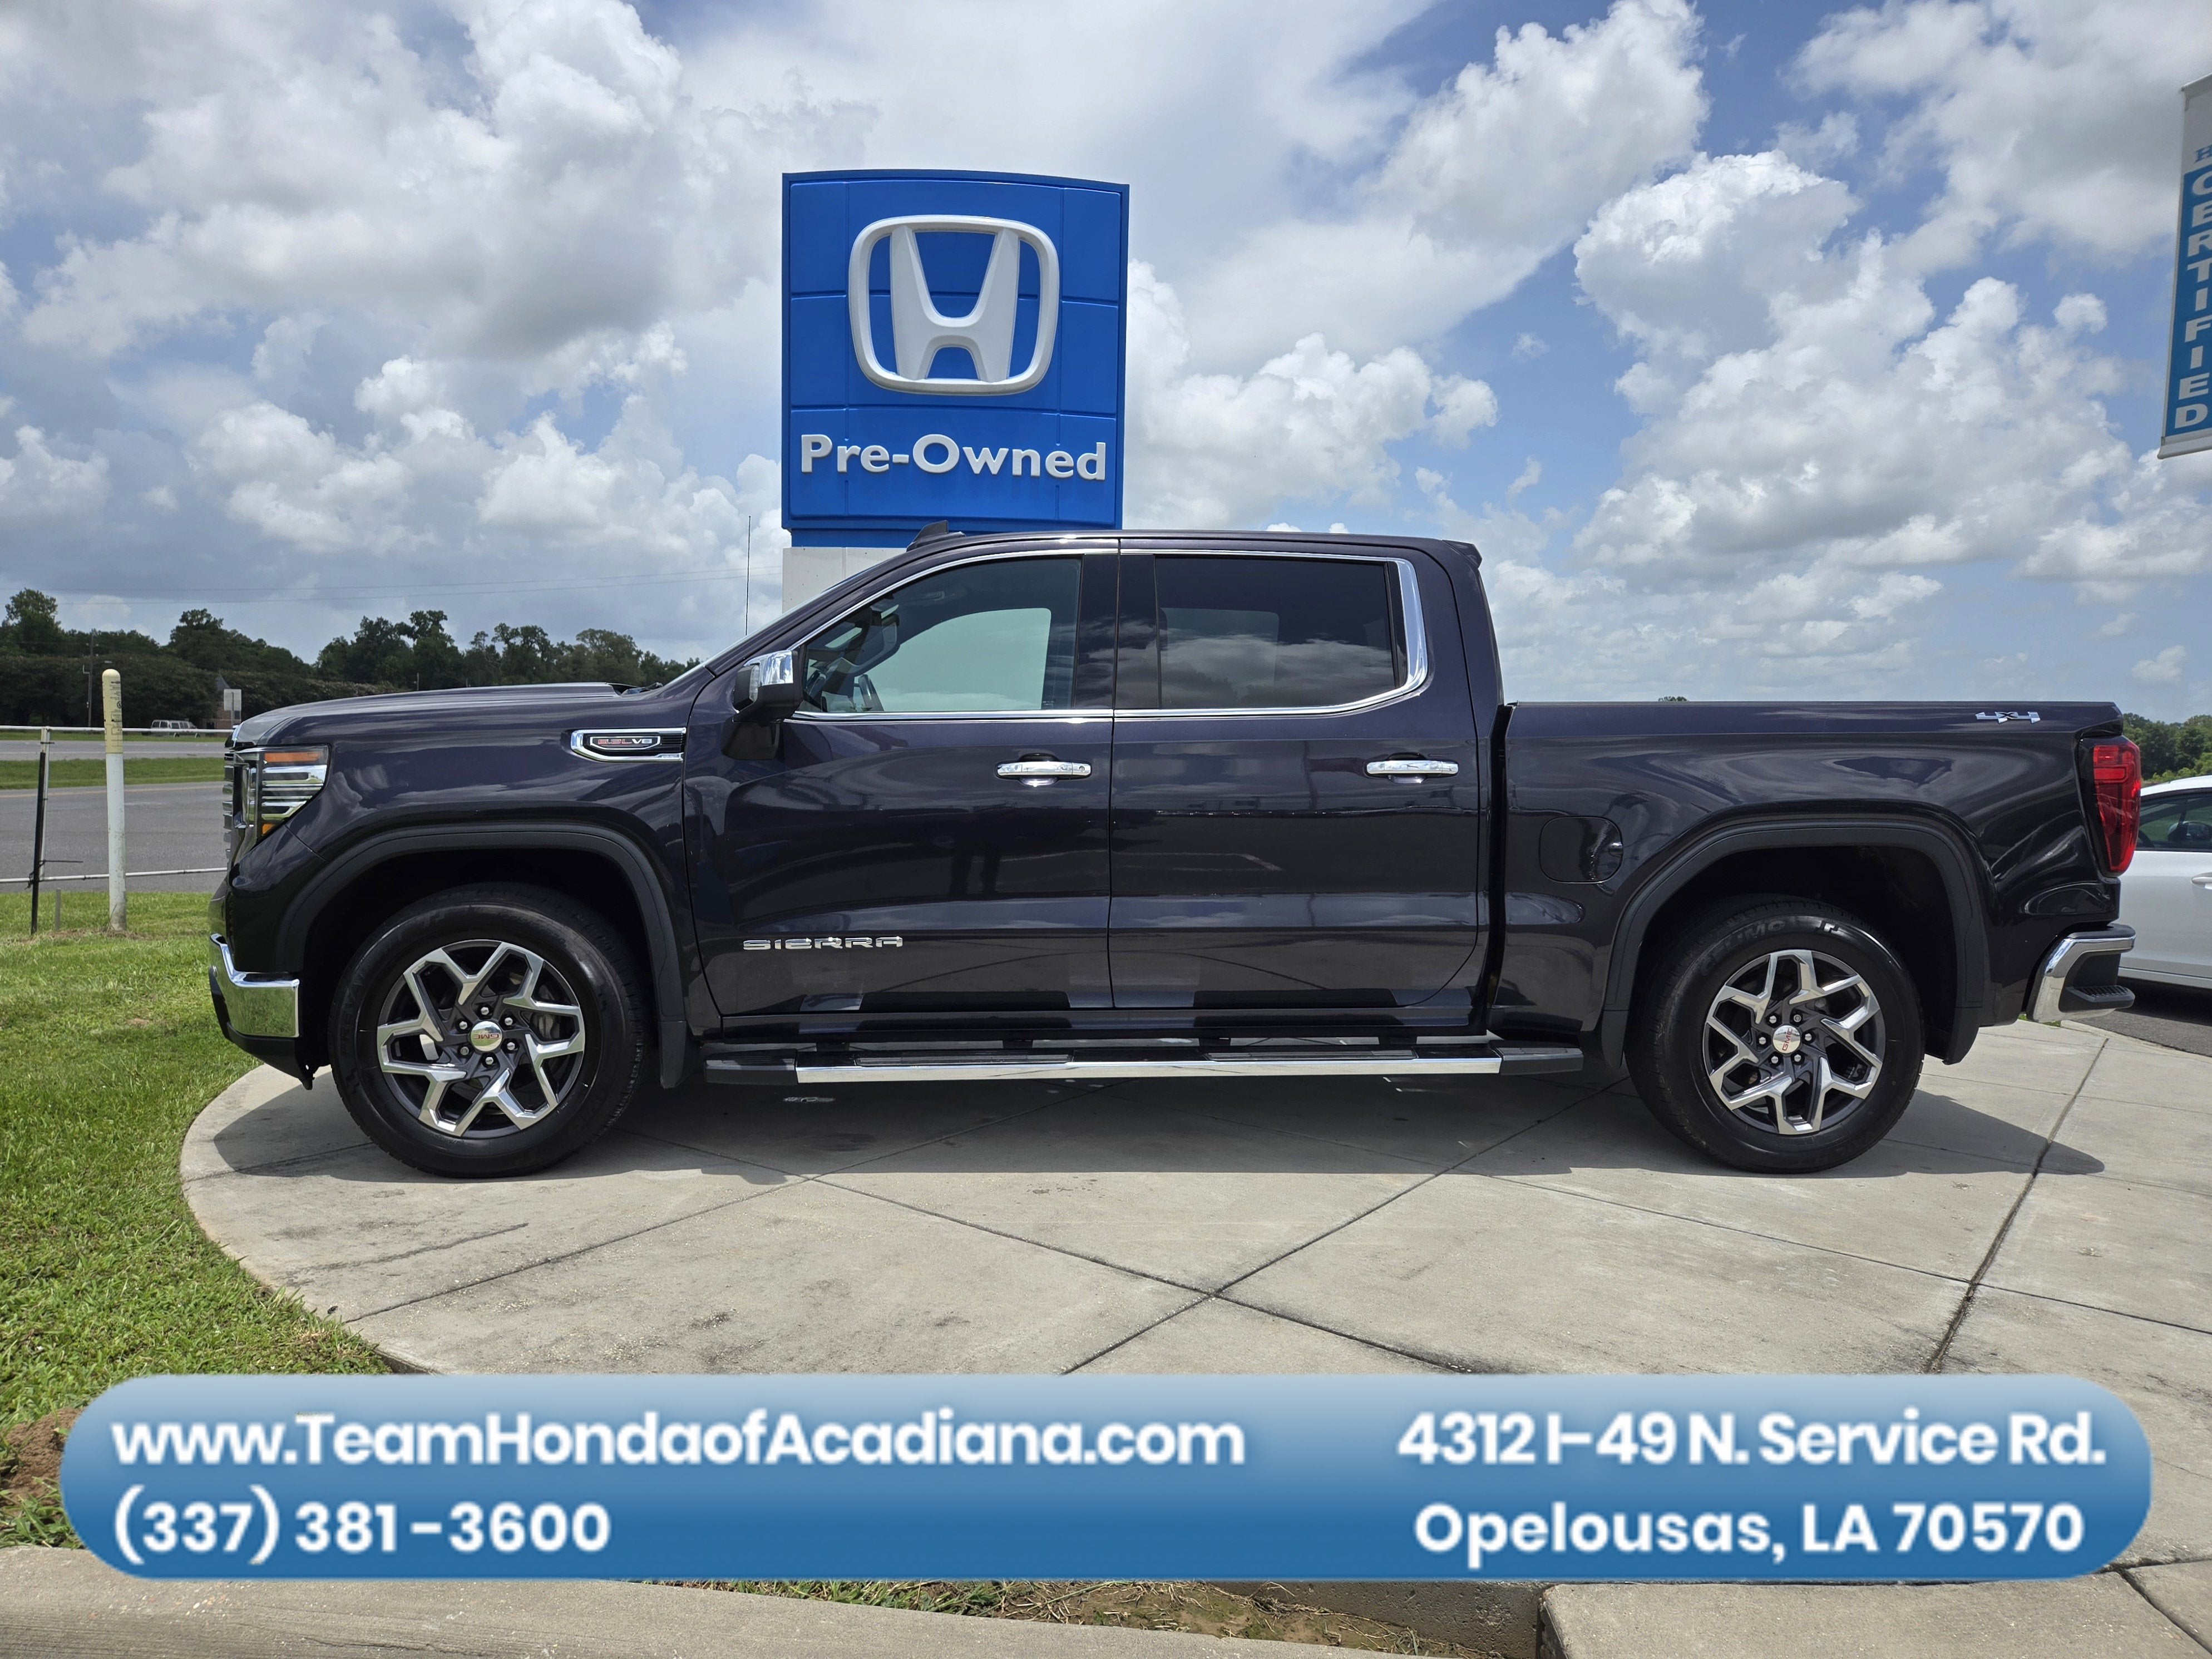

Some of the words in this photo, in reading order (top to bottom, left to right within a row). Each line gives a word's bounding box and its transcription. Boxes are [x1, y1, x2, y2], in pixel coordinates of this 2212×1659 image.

[801, 433, 1106, 481] Pre-Owned
[743, 936, 903, 950] SIERRA
[1781, 1027, 1794, 1051] GMC
